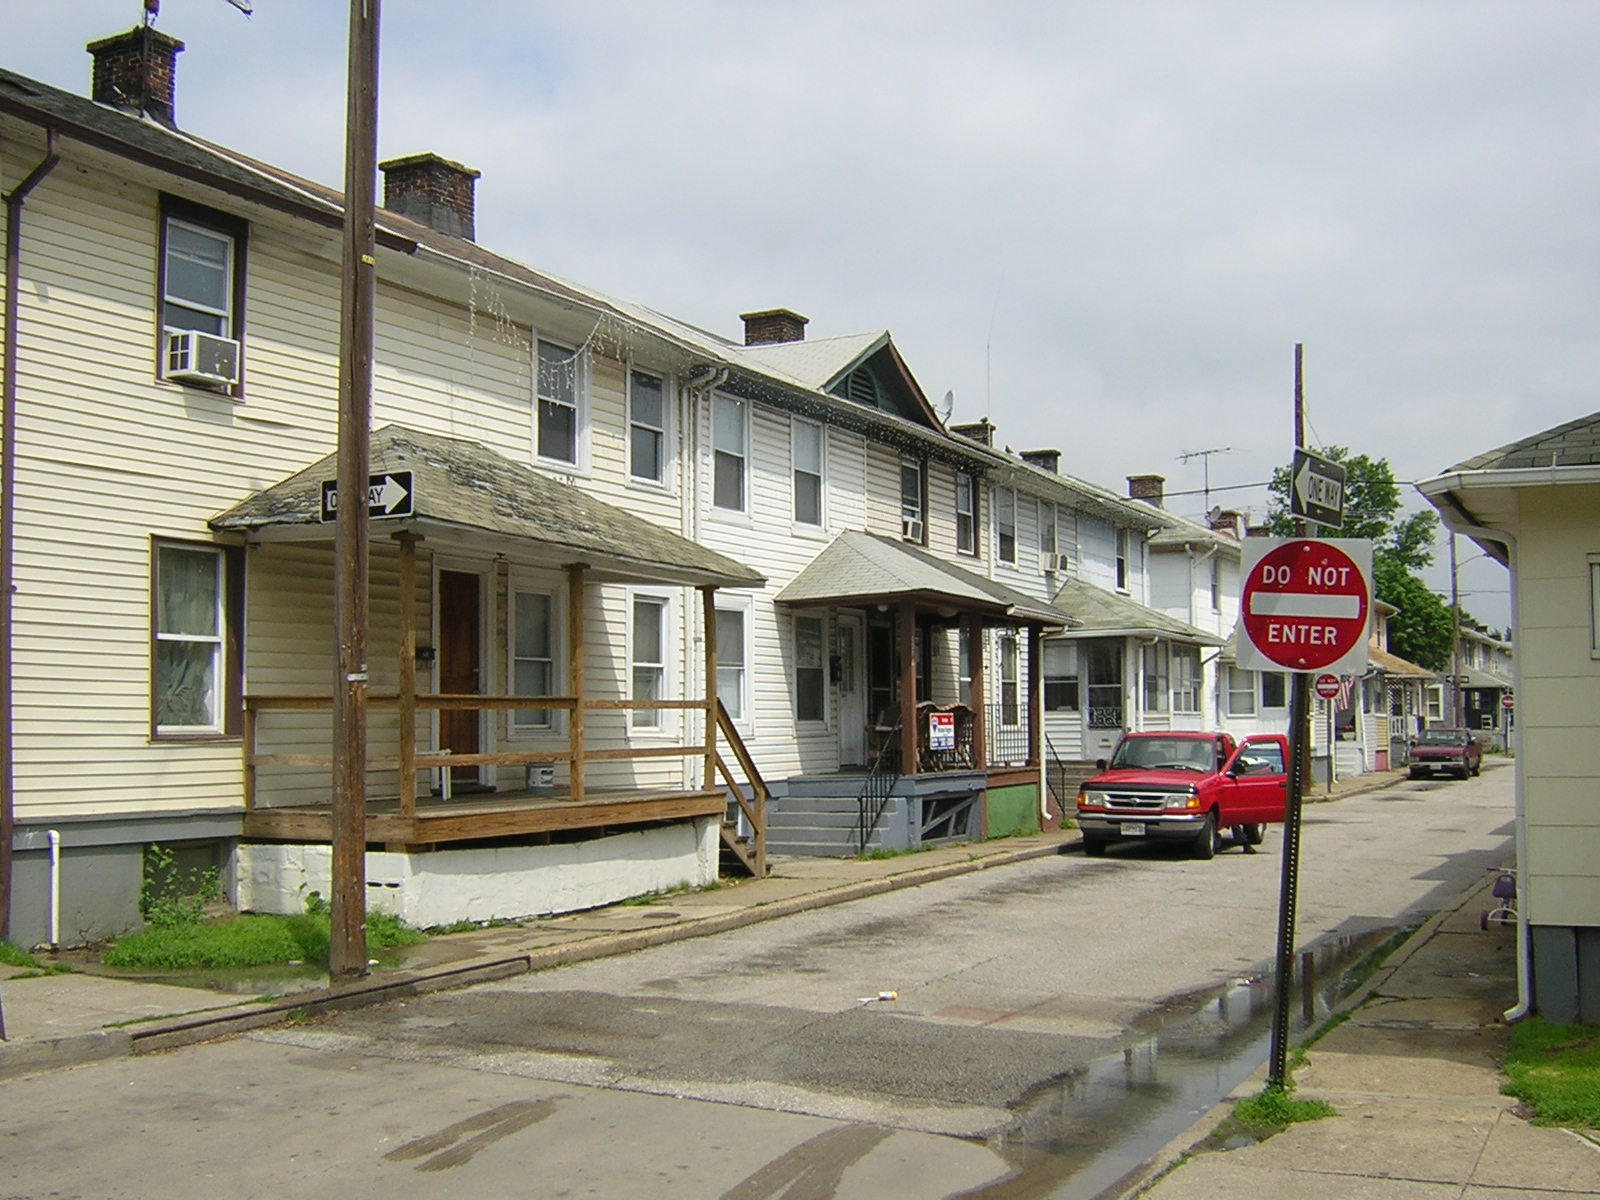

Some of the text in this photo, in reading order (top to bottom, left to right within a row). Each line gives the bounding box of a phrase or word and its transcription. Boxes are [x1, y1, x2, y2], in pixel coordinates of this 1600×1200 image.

[1308, 475, 1340, 508] ONE WAY
[1262, 564, 1351, 587] DO NOT
[1267, 623, 1338, 646] ENTER
